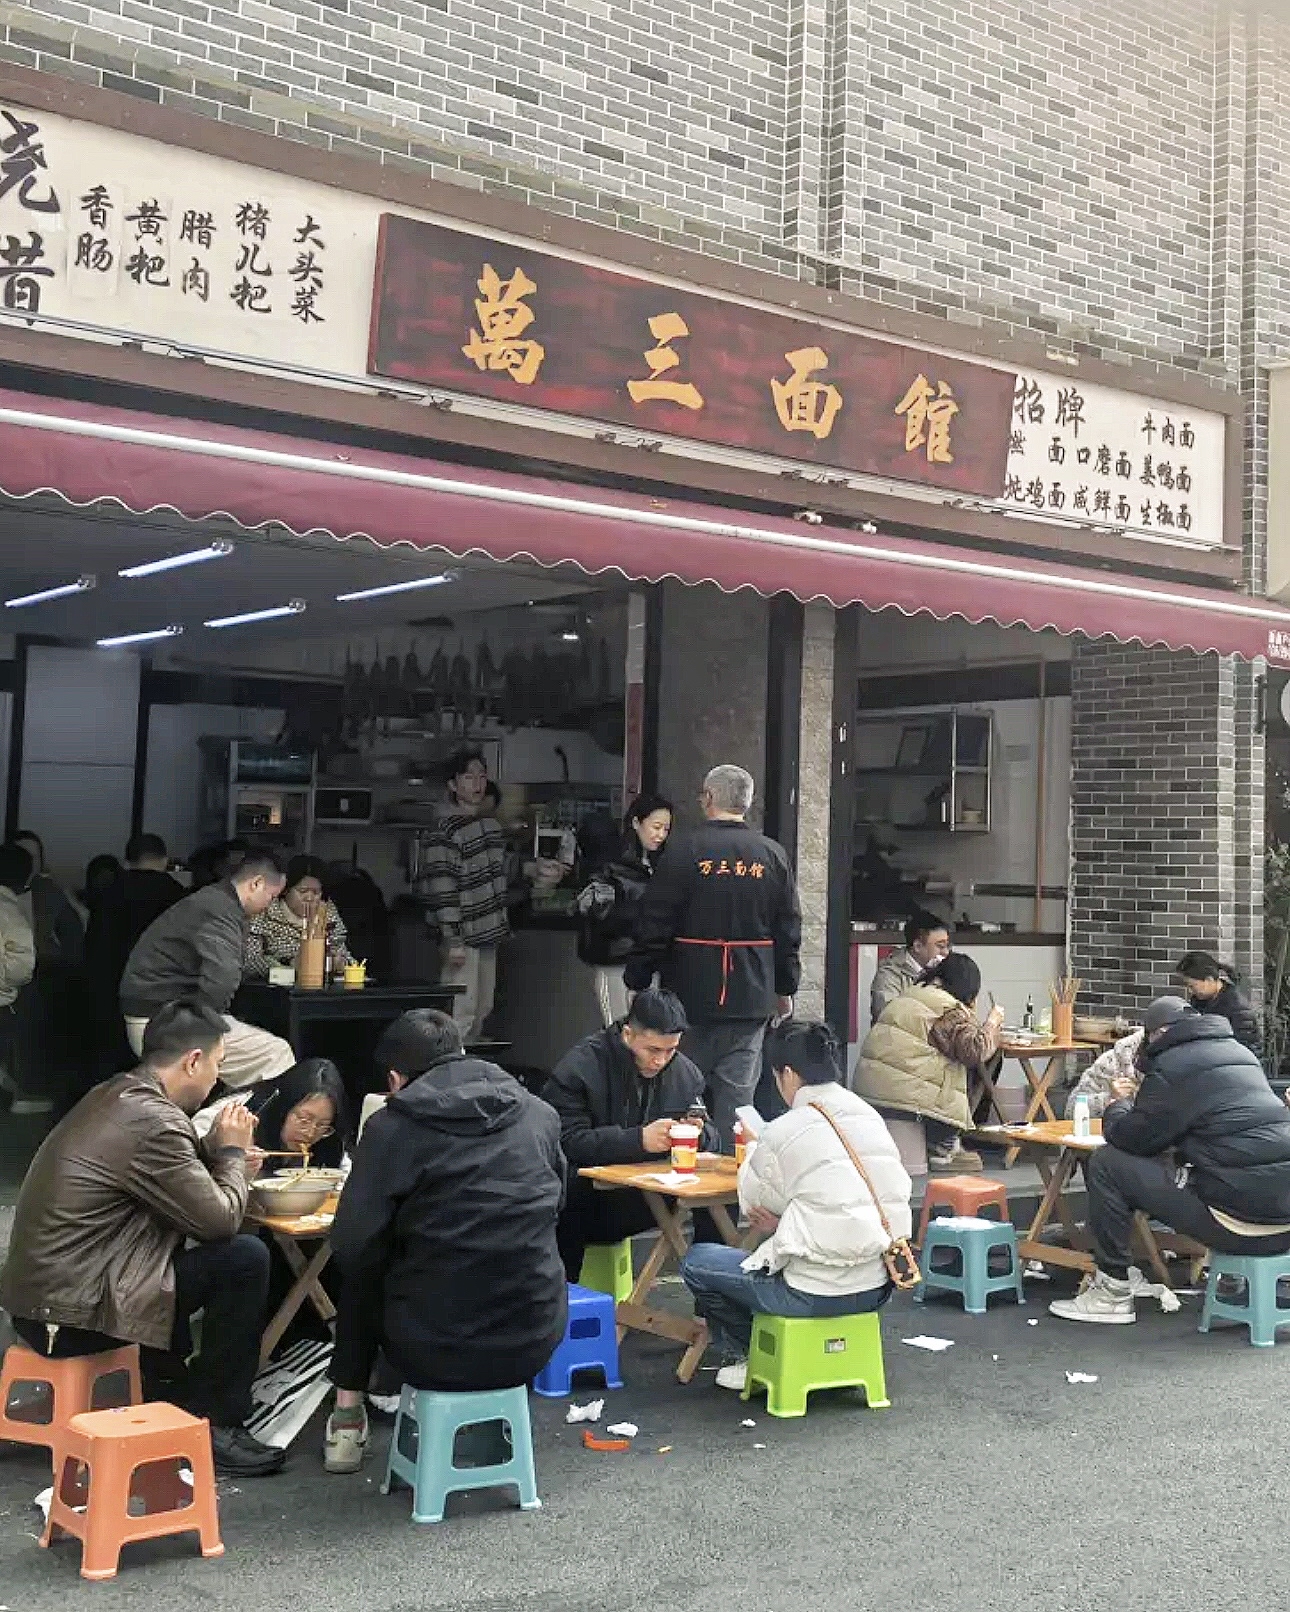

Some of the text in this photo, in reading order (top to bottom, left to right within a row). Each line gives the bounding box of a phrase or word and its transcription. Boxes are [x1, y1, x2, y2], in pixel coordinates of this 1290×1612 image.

[74, 185, 115, 273] 香肠
[124, 199, 171, 287] 黄粑
[180, 209, 217, 303] 腊肉
[229, 202, 273, 314] 猪儿粑
[287, 214, 326, 325] 大头菜
[462, 262, 961, 465] 萬三面館
[1013, 377, 1087, 438] 招牌
[1139, 453, 1192, 494] 姜鸭面
[1140, 411, 1195, 449] 牛肉面
[1073, 484, 1132, 523] 咸鲜面
[1139, 498, 1192, 532] 生椒面
